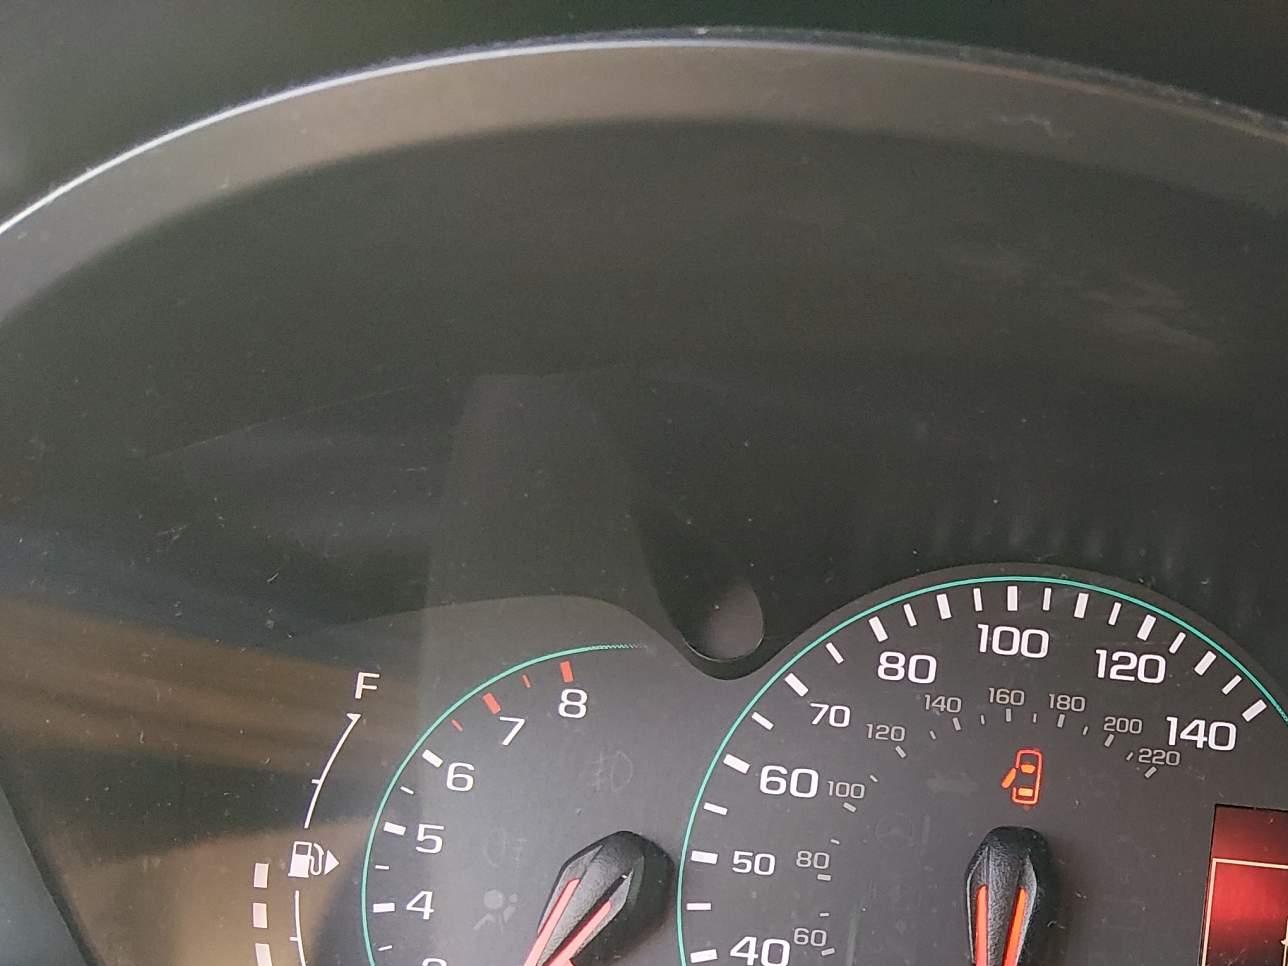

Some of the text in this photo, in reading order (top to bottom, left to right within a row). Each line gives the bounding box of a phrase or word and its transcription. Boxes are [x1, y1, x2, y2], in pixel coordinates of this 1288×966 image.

[977, 624, 1049, 659] 100
[877, 651, 938, 684] 80
[1096, 649, 1166, 684] 120
[355, 672, 381, 699] F
[987, 687, 1025, 706] 160
[558, 689, 587, 719] 8
[809, 703, 851, 729] 70
[924, 695, 962, 715] 140
[1048, 693, 1086, 713] 180
[499, 716, 526, 746] 7
[866, 724, 906, 744] 120
[1103, 716, 1143, 735] 200
[1166, 716, 1237, 753] 140
[1138, 748, 1181, 768] 220
[446, 762, 475, 792] 6
[759, 765, 818, 799] 60
[827, 781, 865, 800] 100
[416, 824, 445, 854] 5
[732, 852, 775, 876] 50
[796, 851, 830, 870] 80
[406, 891, 435, 920] 4
[793, 928, 828, 948] 60
